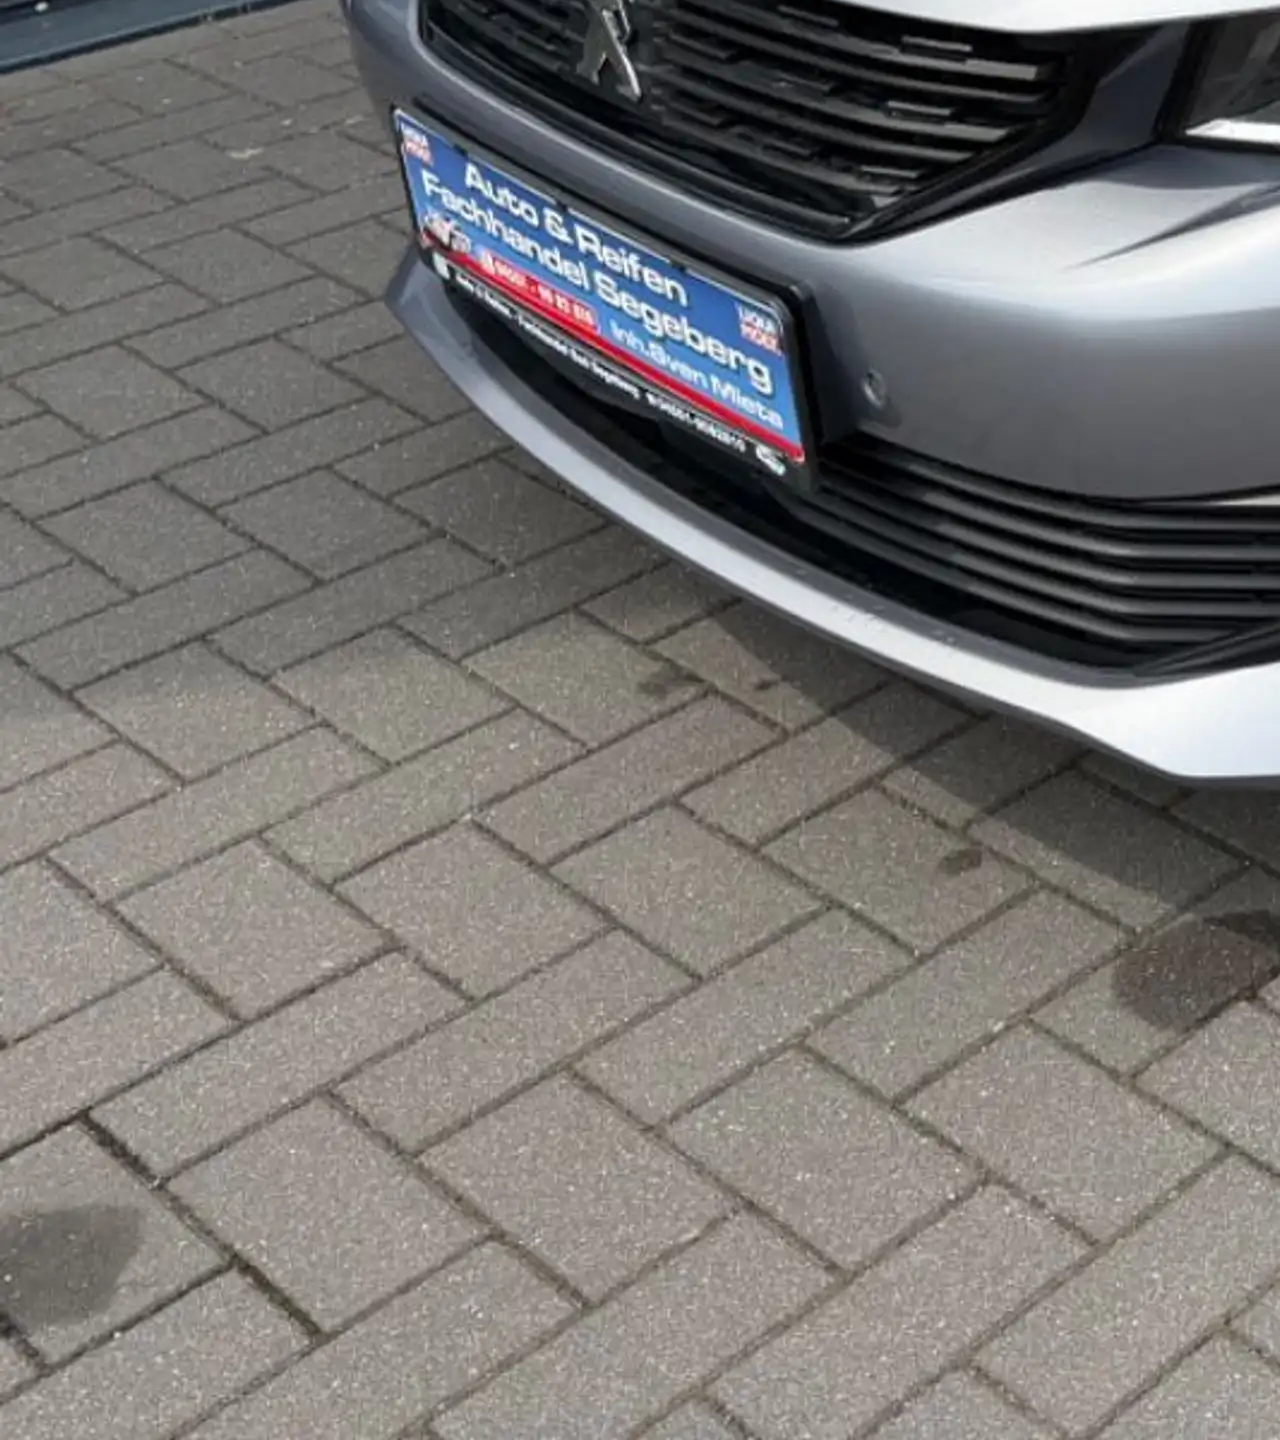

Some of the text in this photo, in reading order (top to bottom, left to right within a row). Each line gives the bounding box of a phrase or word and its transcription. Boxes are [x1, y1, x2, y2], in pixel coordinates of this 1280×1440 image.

[421, 168, 592, 291] Fachhandel
[593, 271, 774, 395] Segeberg
[465, 162, 539, 227] Auto
[543, 207, 574, 245] &
[574, 223, 688, 307] Reifen
